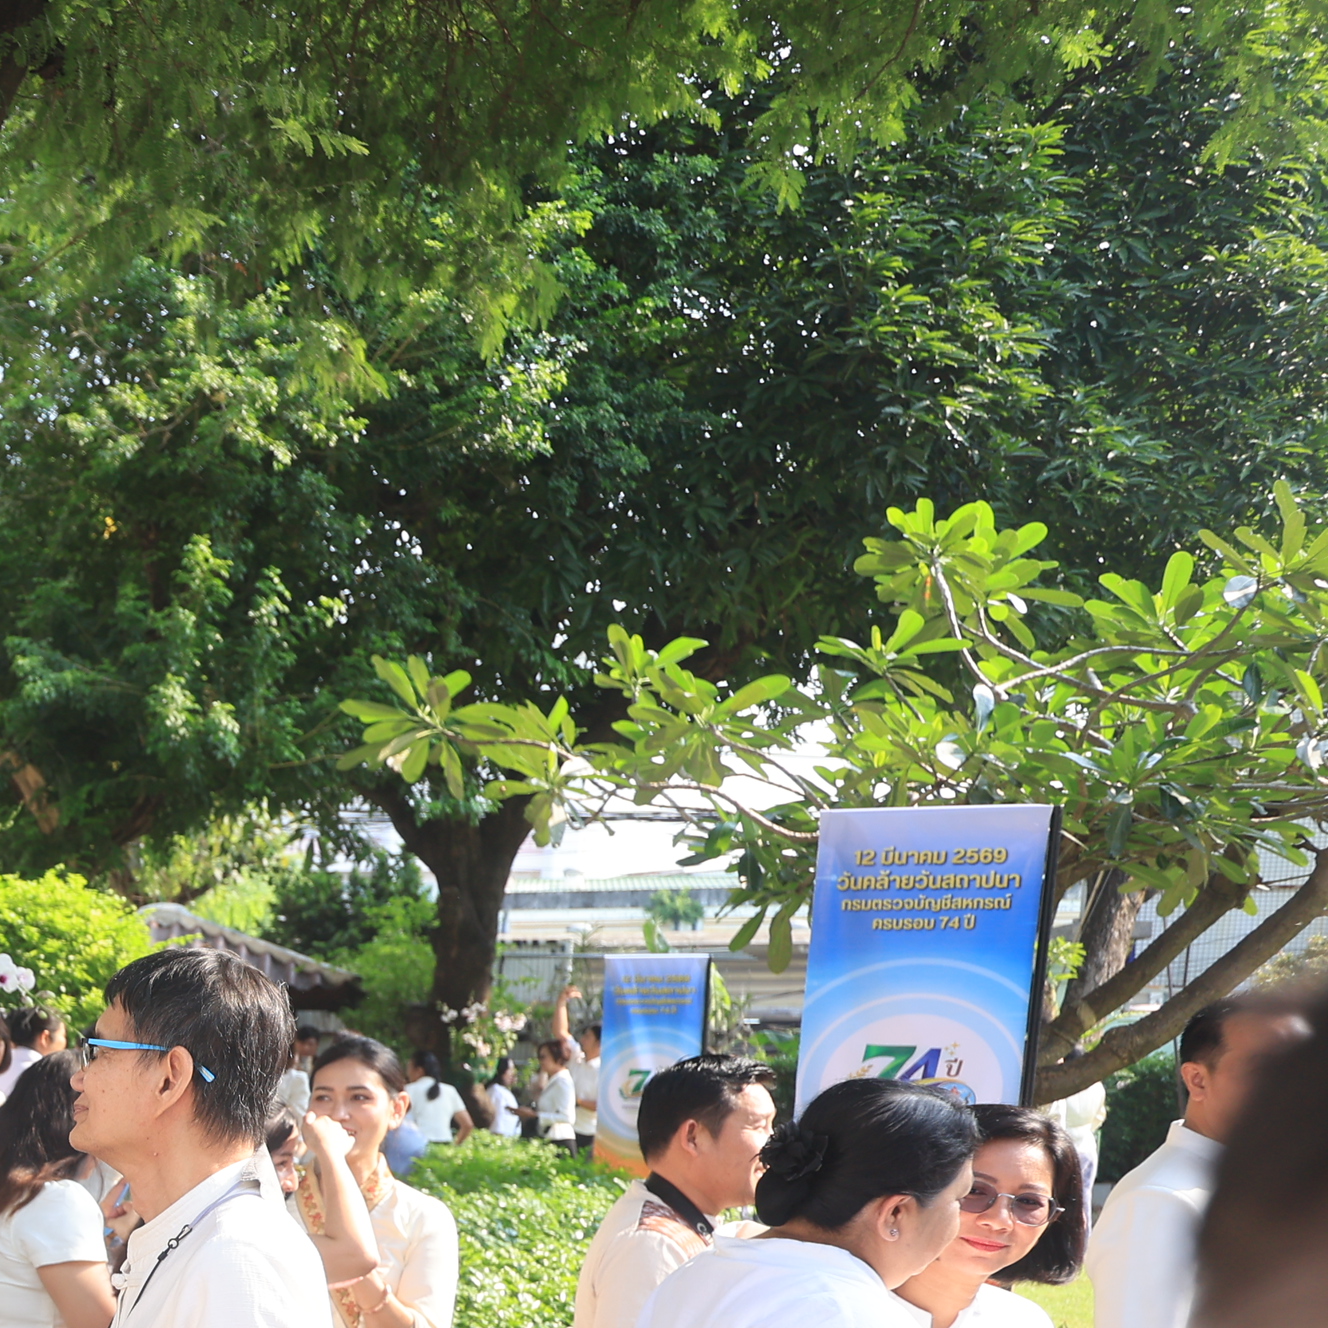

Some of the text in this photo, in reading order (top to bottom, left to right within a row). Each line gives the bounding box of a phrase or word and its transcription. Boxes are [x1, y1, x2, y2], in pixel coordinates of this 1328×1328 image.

[854, 846, 1007, 866] 12 มีนาคม 2569
[836, 870, 1021, 891] วันคล้ายวันสถาปนา
[841, 893, 1013, 912] กรมตรวจบัญชีสหกรณ์
[872, 913, 976, 930] ครบรอบ 74 ปี
[861, 1044, 964, 1082] 74 ปี
